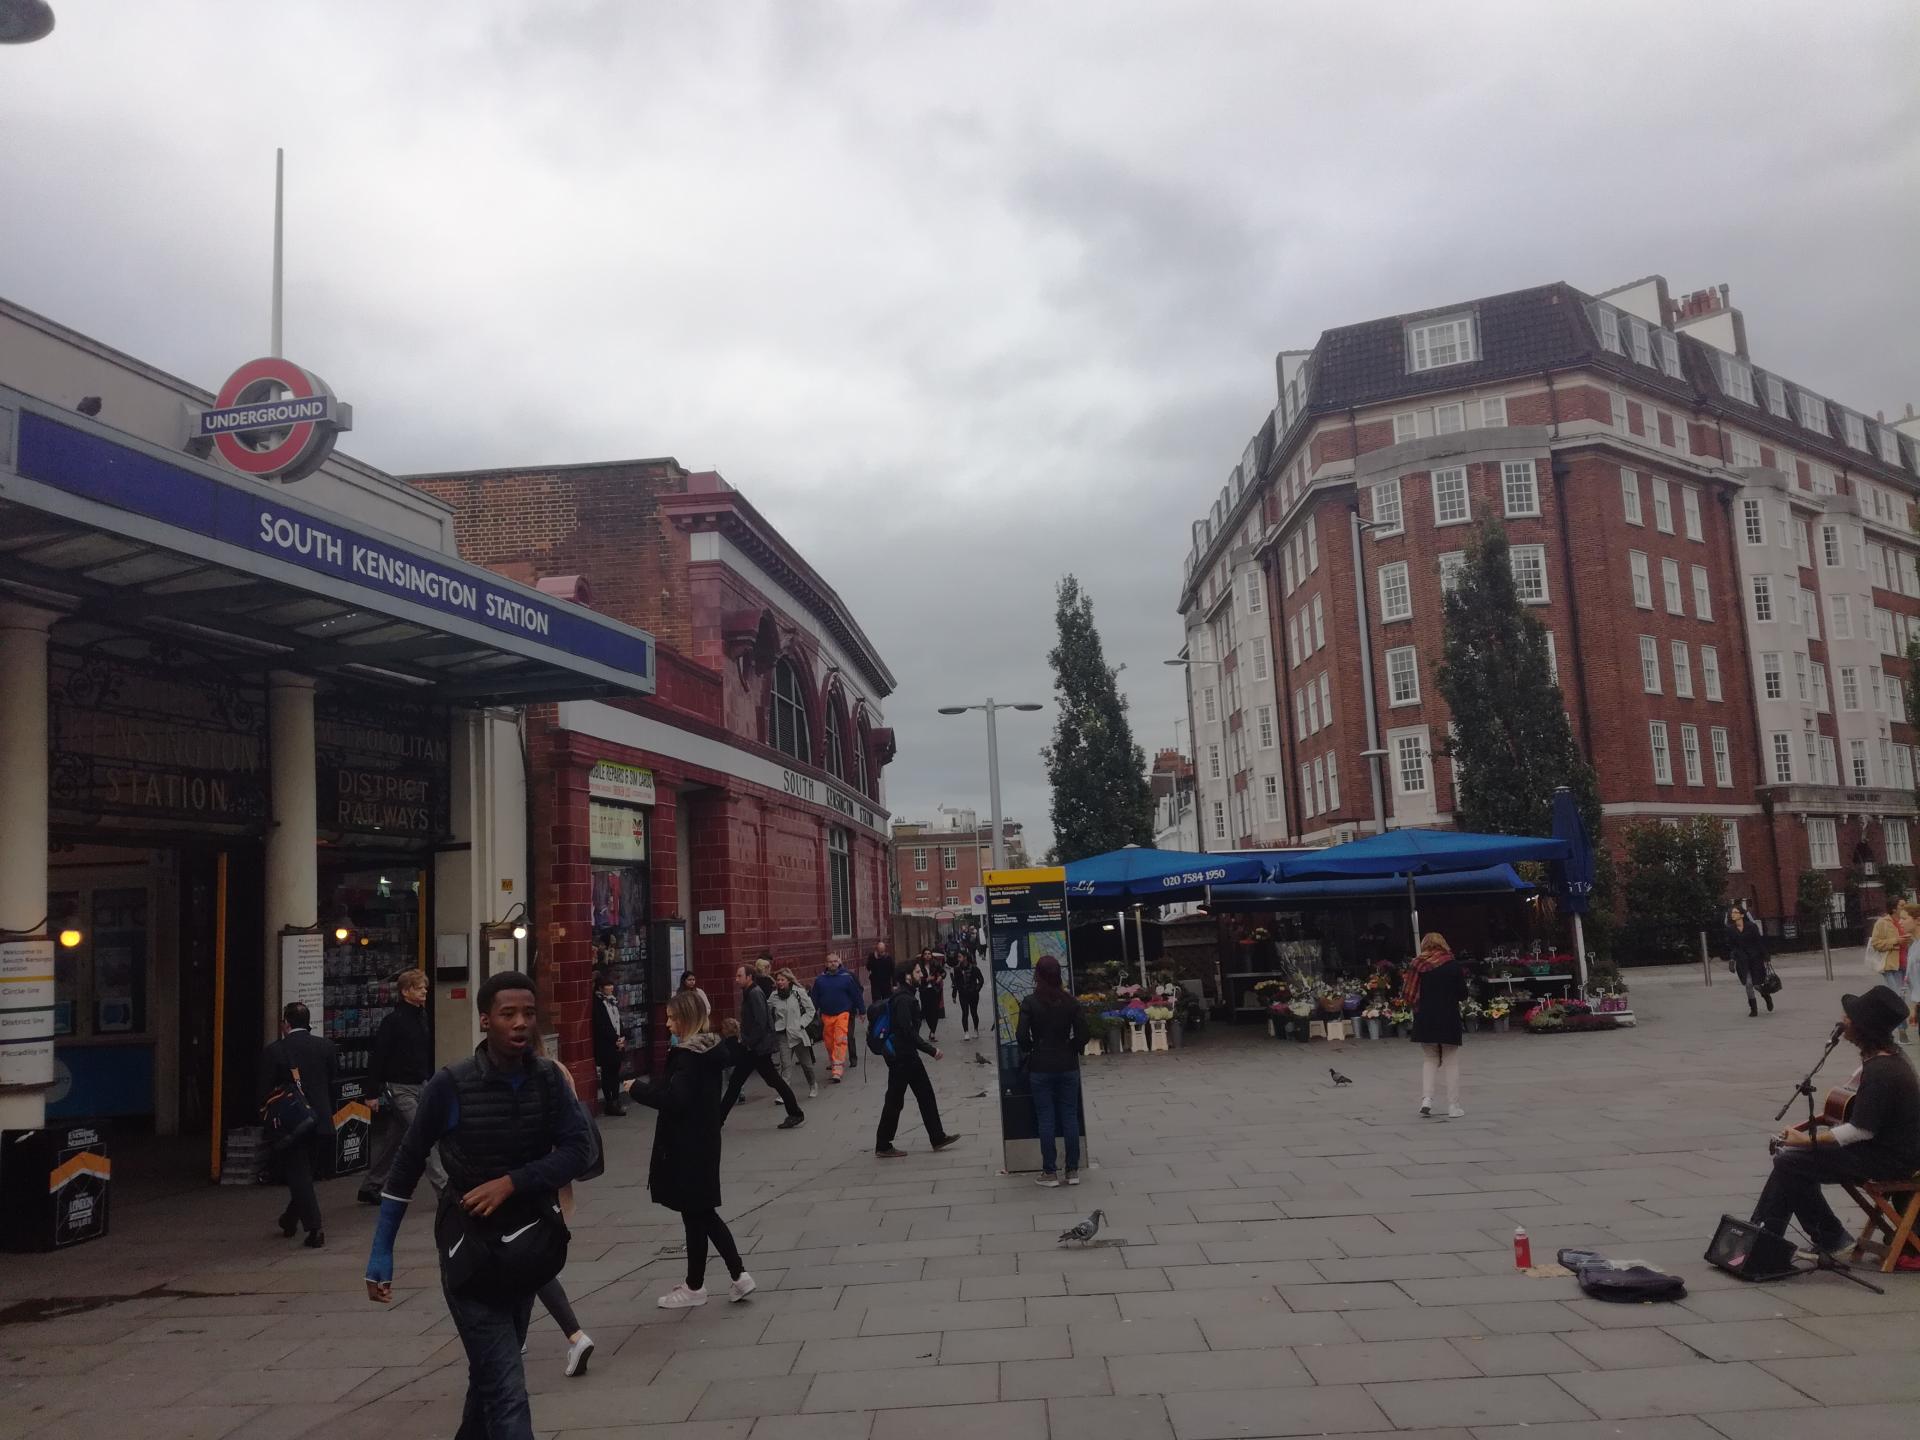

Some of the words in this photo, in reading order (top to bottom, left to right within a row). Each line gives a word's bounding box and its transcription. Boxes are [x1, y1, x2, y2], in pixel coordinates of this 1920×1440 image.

[205, 401, 324, 430] UNDERGROUND
[260, 512, 343, 567] SOUTH
[352, 544, 477, 612] KENSINGTON
[486, 592, 549, 636] STATION
[105, 769, 228, 812] STATION
[337, 769, 429, 803] DISTRICT
[783, 770, 815, 801] SOUTH
[826, 786, 855, 818] KENSINGTON
[337, 799, 430, 831] RAILWAYS
[1072, 880, 1095, 895] Lily
[1162, 876, 1181, 888] 020
[1182, 873, 1204, 885] 7584
[1205, 868, 1226, 881] 1950
[2, 987, 26, 996] Circle
[2, 1016, 31, 1027] District
[1, 1047, 37, 1058] Piccadilly
